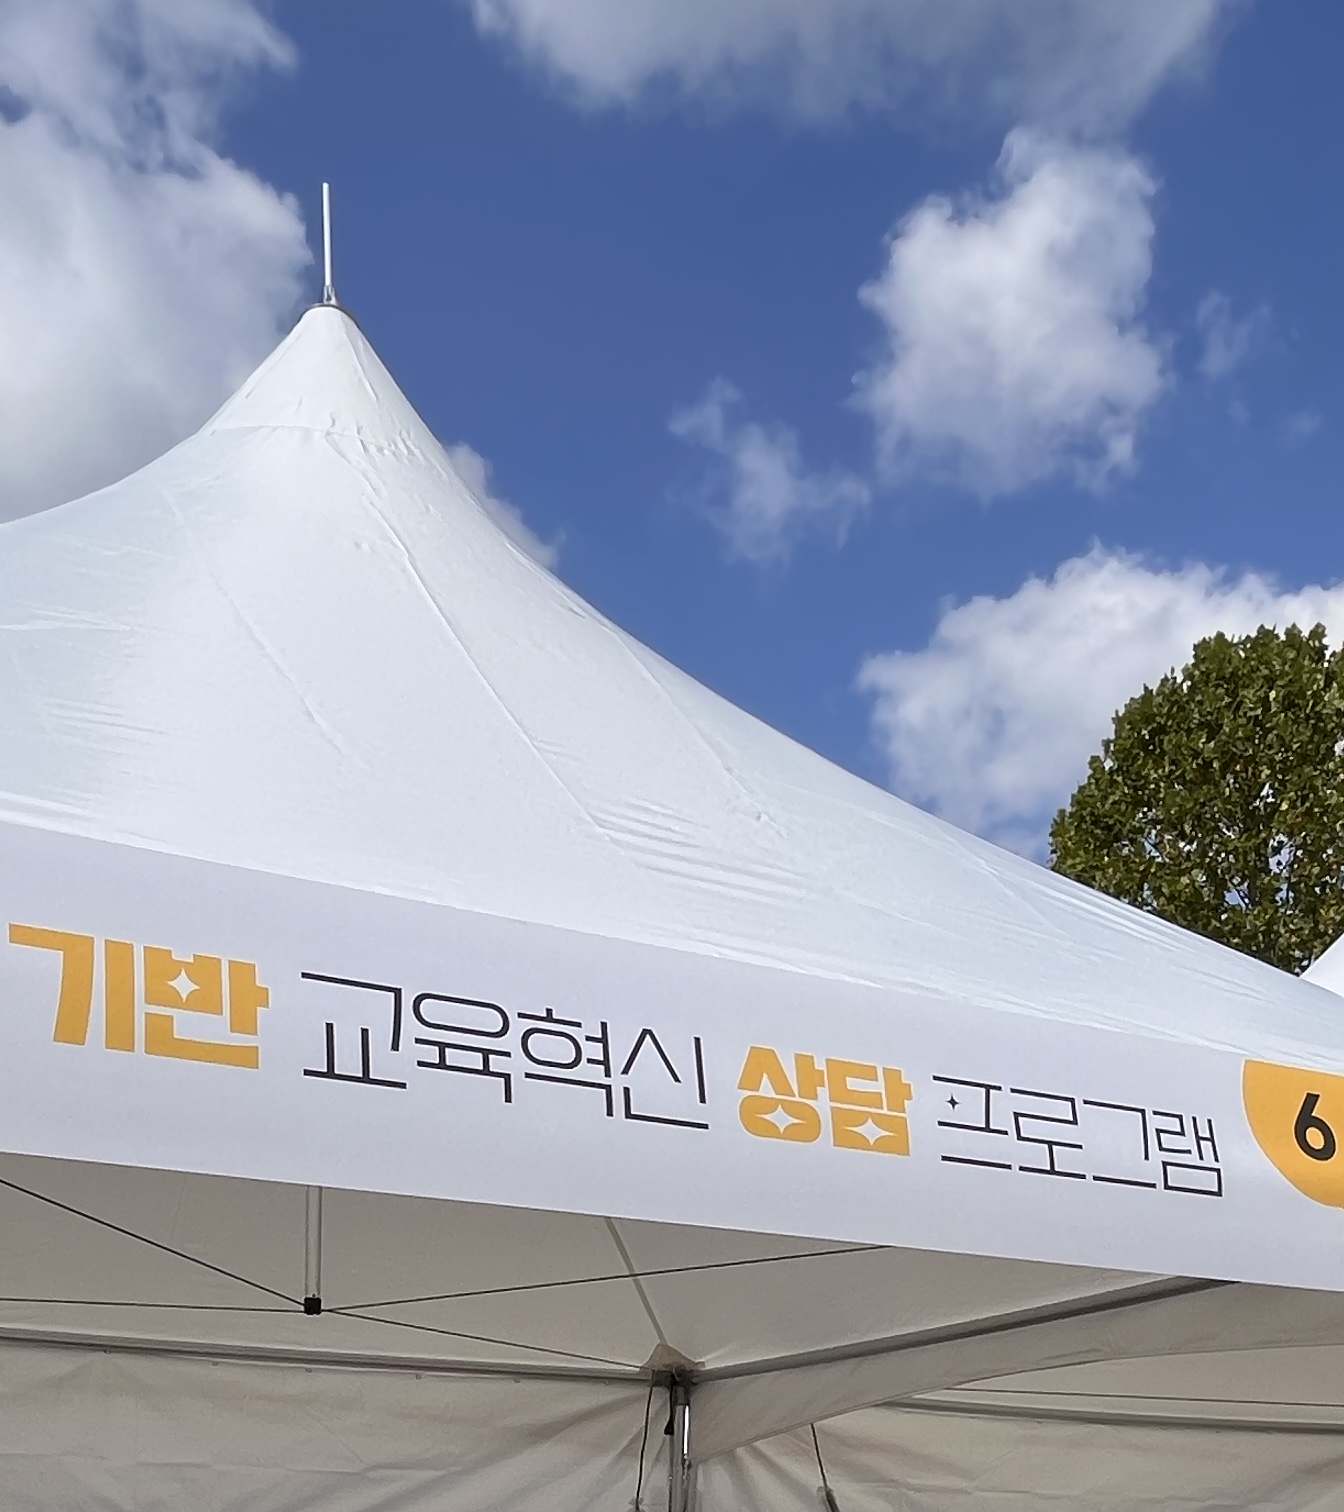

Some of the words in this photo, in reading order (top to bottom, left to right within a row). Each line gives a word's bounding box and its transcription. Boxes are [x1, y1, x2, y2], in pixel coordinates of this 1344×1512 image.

[8, 922, 270, 1070] 기반
[300, 970, 710, 1130] 교육혁신
[736, 1043, 913, 1157] 상담
[931, 1073, 1224, 1198] 프로그램
[1293, 1091, 1337, 1162] 6
